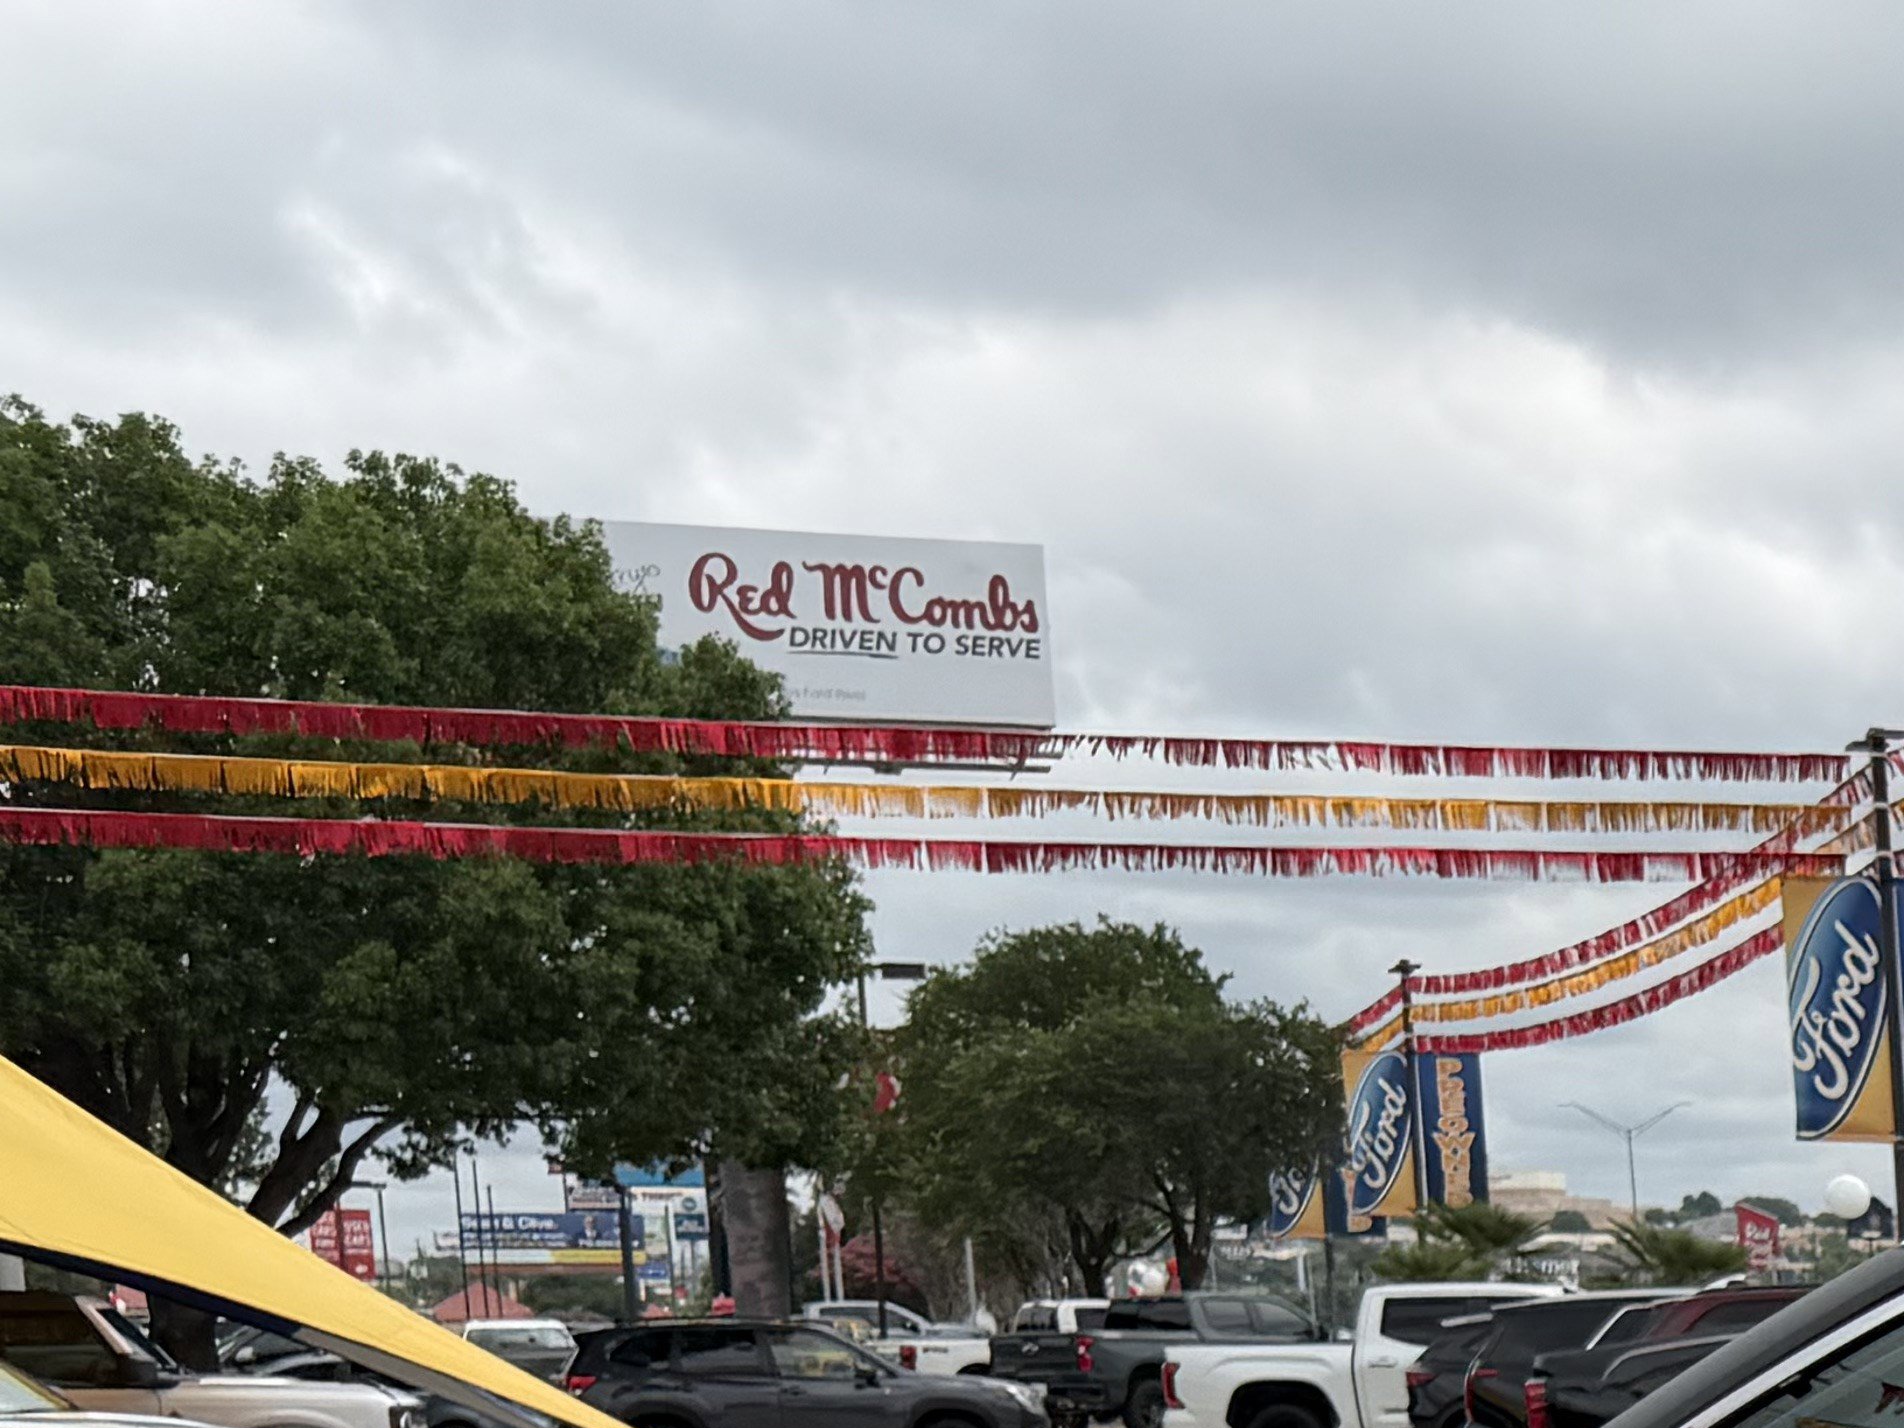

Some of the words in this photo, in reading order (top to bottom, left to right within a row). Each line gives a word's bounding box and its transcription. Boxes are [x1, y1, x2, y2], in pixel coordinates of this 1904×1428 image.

[688, 552, 796, 641] Red
[802, 559, 1039, 634] McCombs
[789, 626, 898, 653] DRIVEN
[907, 632, 946, 654] TO
[955, 635, 1041, 659] SERVE
[1793, 920, 1880, 1099] Ford
[1351, 1076, 1407, 1189] Ford
